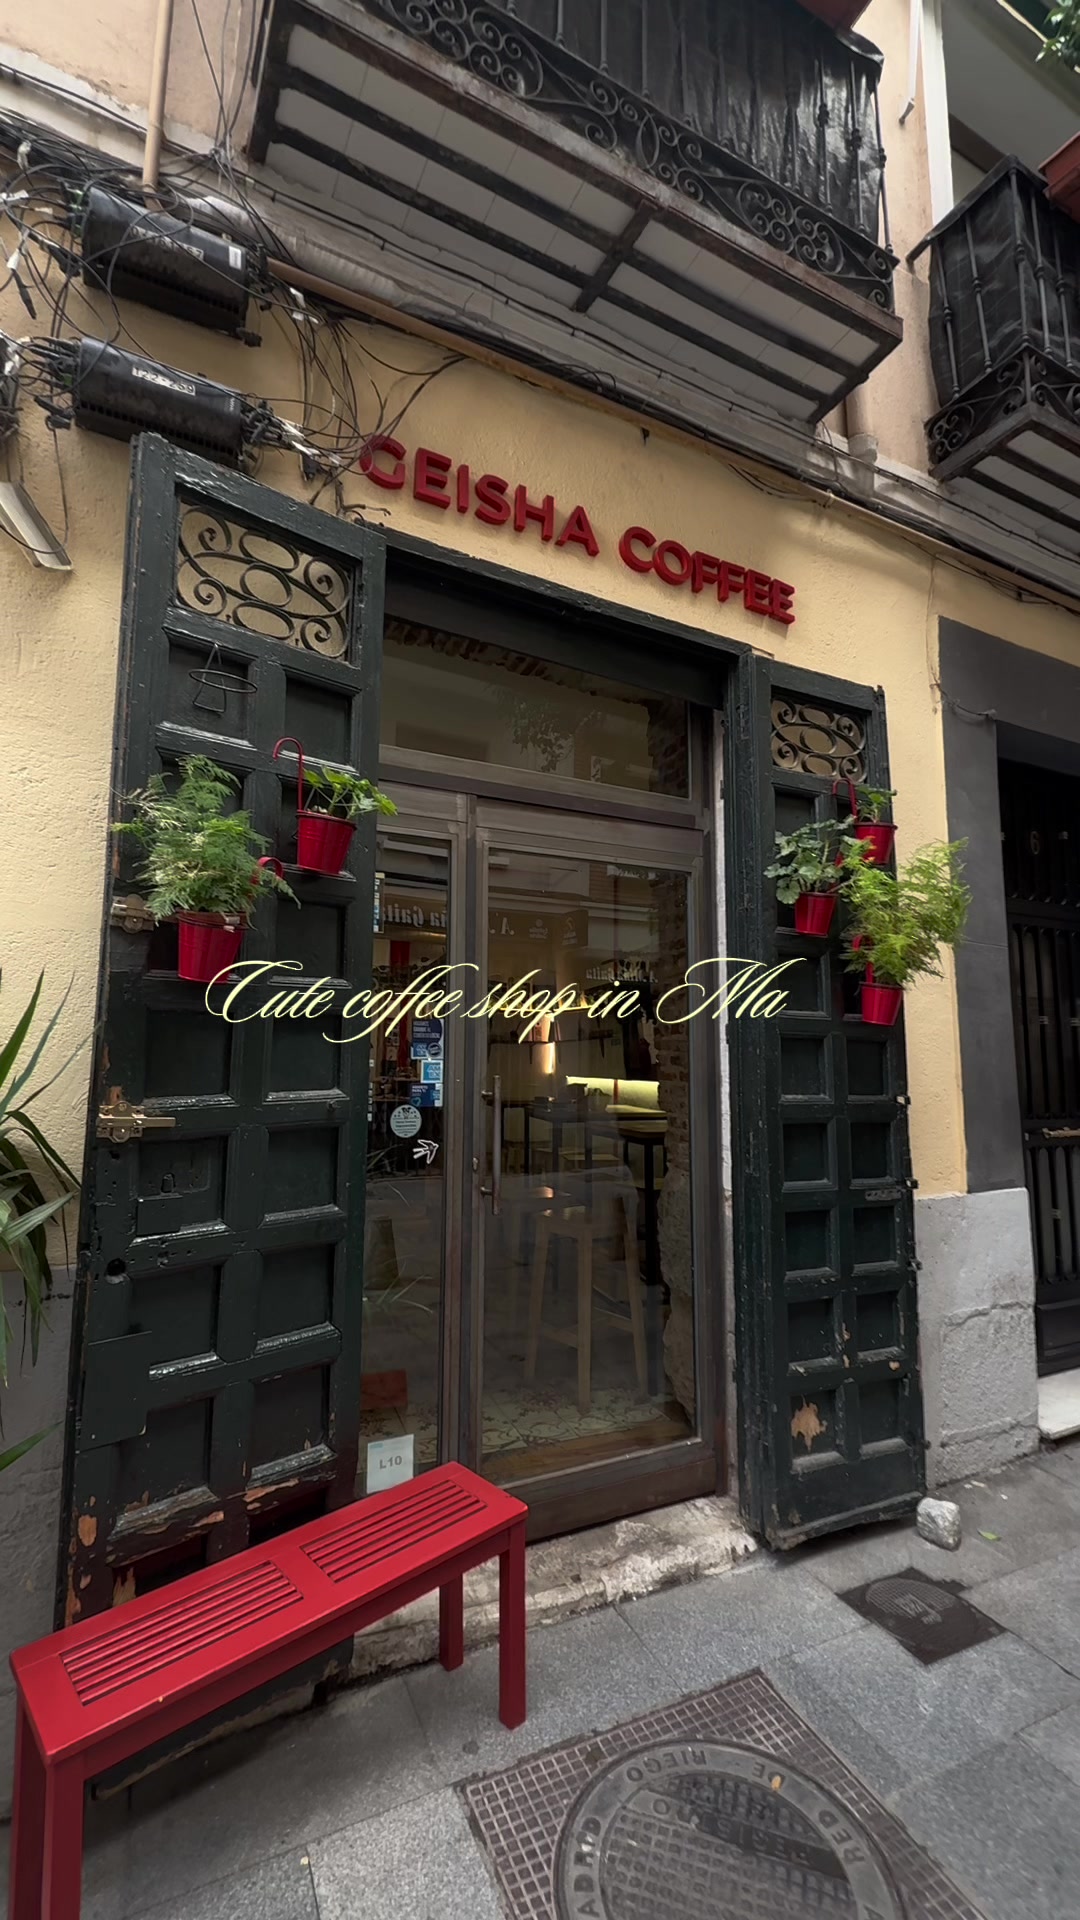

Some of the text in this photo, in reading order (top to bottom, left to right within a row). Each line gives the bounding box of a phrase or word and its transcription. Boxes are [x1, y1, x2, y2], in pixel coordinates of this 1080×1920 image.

[359, 434, 795, 625] GEISHA COFFEE
[379, 1455, 403, 1470] L10
[625, 1749, 868, 1867] RED DE RIEGO
